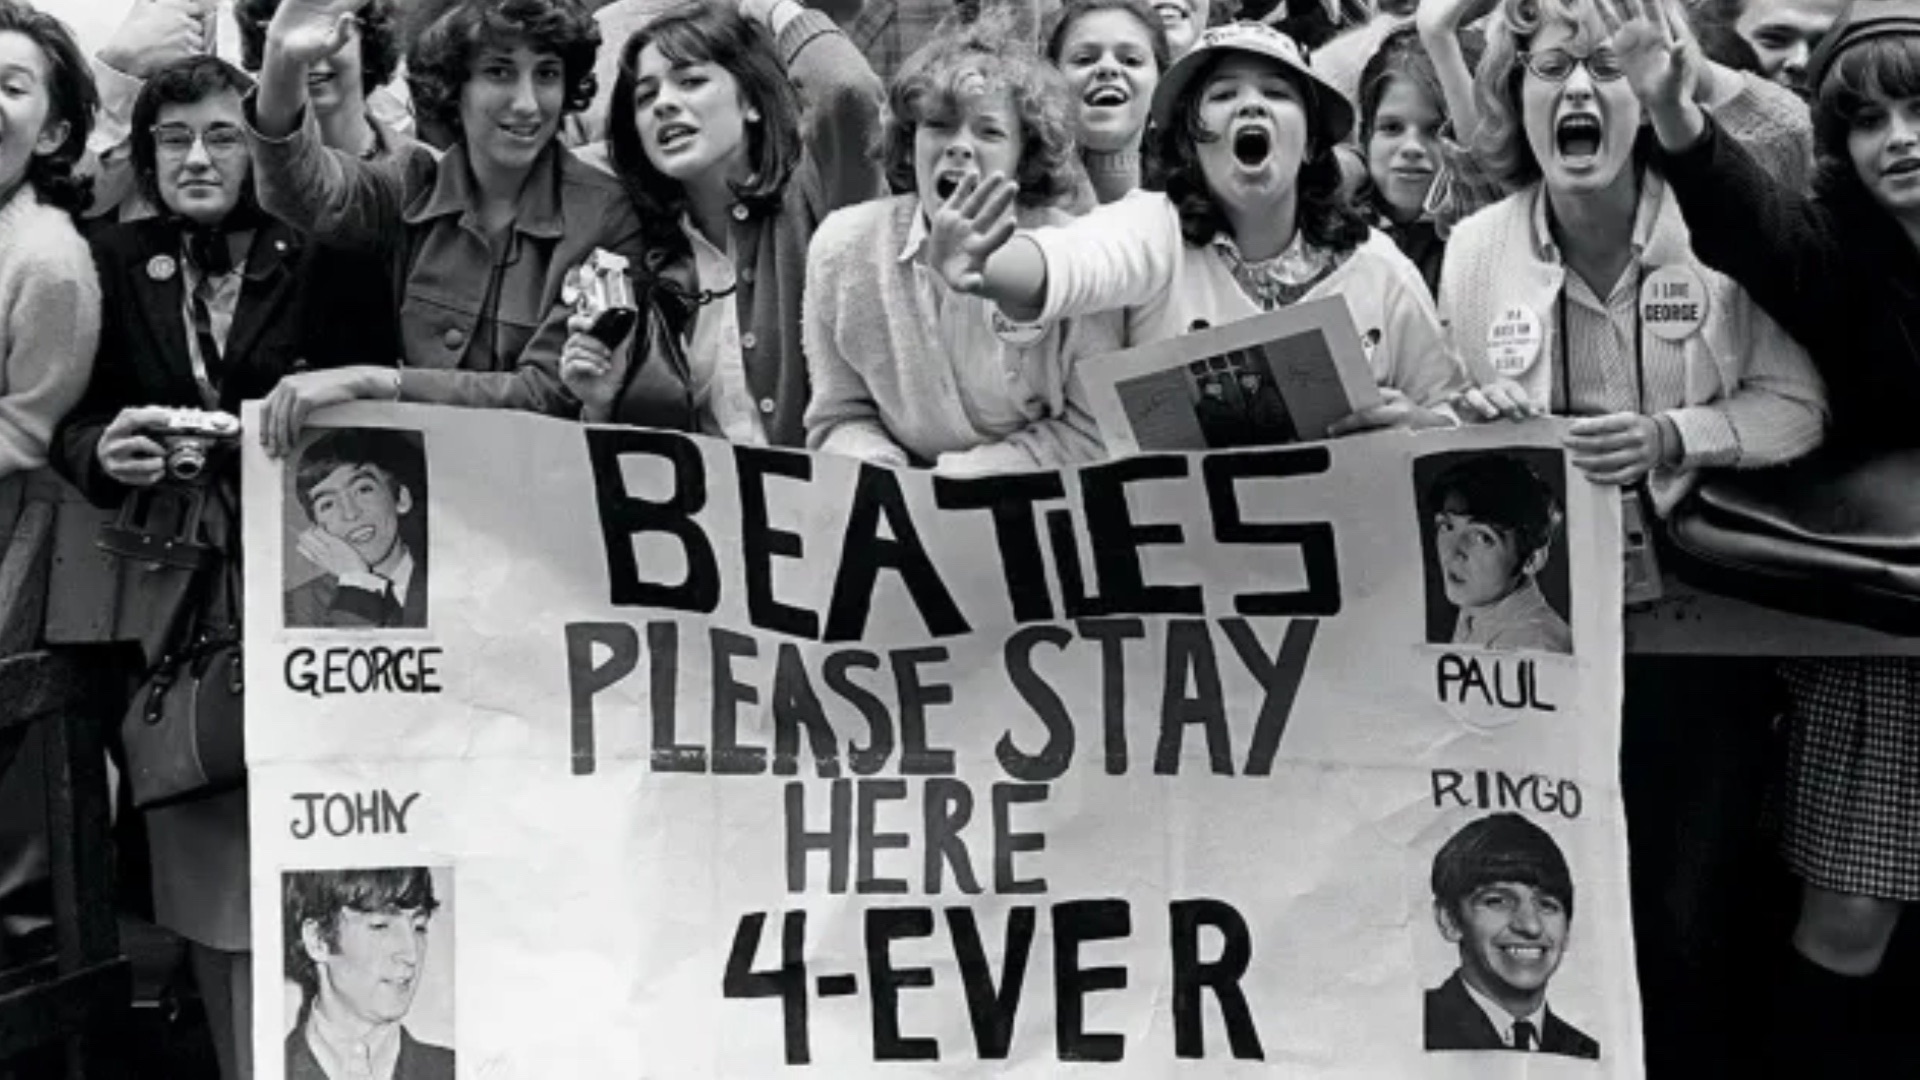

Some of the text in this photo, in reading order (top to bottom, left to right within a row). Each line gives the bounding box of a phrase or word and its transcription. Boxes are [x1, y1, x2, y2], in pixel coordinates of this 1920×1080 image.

[1644, 303, 1699, 322] GEORGE
[1663, 282, 1690, 299] LOVE
[586, 427, 1342, 642] BEATLES
[284, 646, 442, 697] GEORGE
[1436, 653, 1556, 711] PAUL
[565, 617, 1320, 781] PLEASE STAY
[290, 789, 420, 839] JOHN
[1431, 769, 1582, 818] RINGO
[784, 778, 1049, 894] HERE
[723, 899, 1265, 1065] 4-EVER
